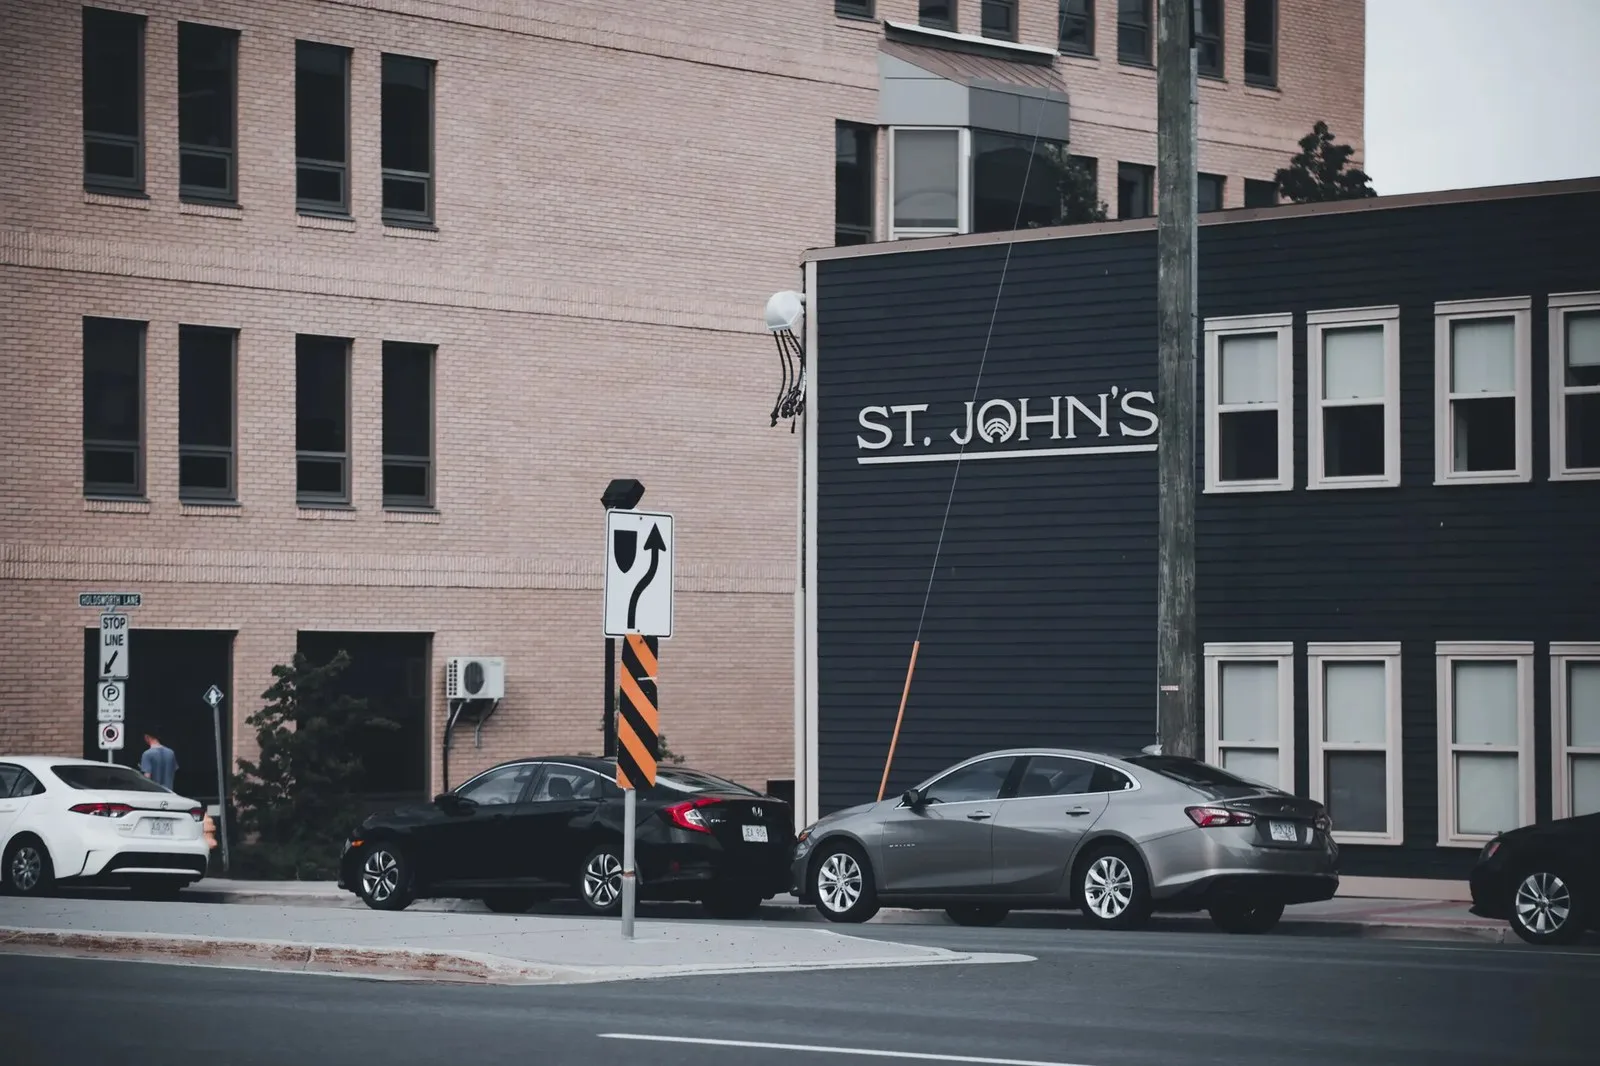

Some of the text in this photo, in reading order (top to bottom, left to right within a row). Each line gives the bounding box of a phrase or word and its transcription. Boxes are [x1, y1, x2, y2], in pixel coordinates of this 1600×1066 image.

[857, 385, 1159, 450] ST. JOHN'S
[81, 595, 139, 605] HOLDSWORTH LANE
[103, 617, 125, 630] STOP
[105, 634, 124, 646] LINE
[107, 688, 116, 698] P
